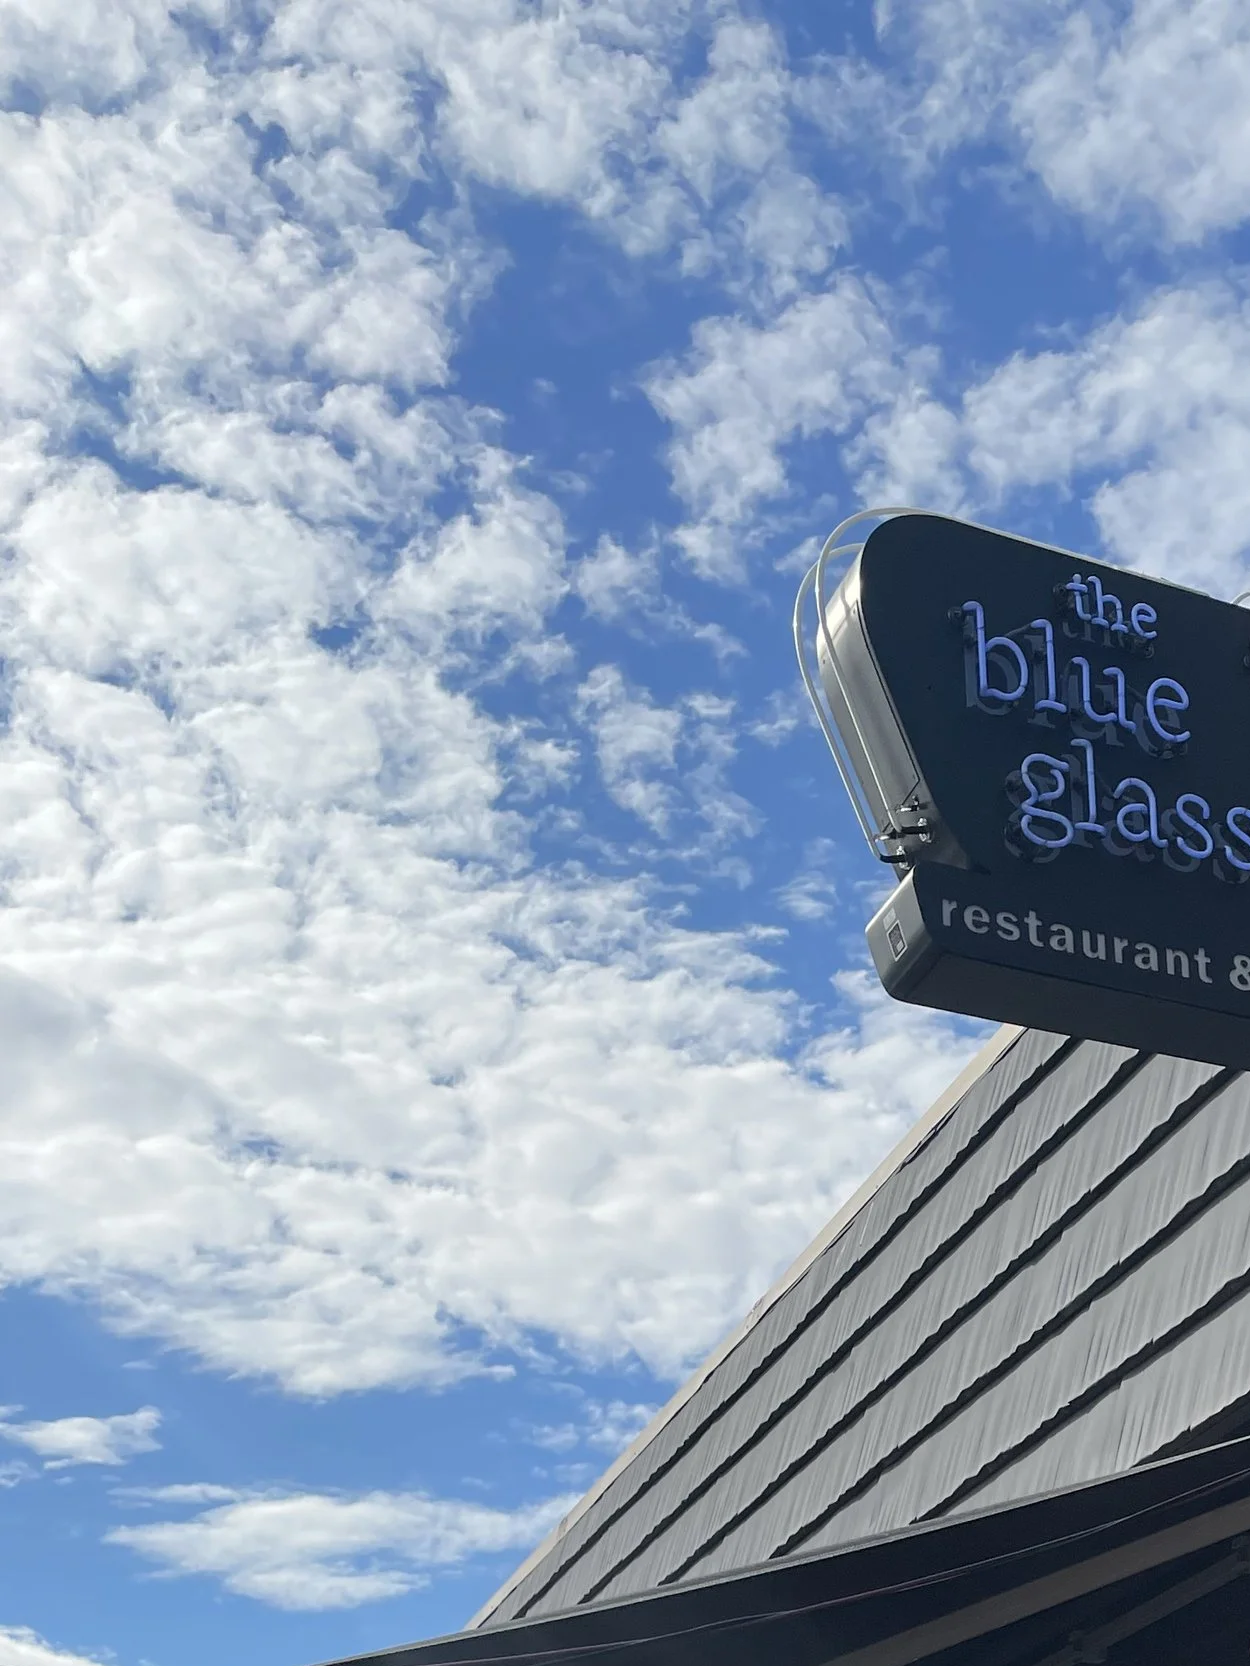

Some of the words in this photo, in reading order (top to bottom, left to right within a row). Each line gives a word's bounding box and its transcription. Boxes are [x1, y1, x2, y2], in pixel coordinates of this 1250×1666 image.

[1065, 573, 1157, 639] the
[962, 601, 1191, 743] blue
[942, 898, 1213, 984] restaurant
